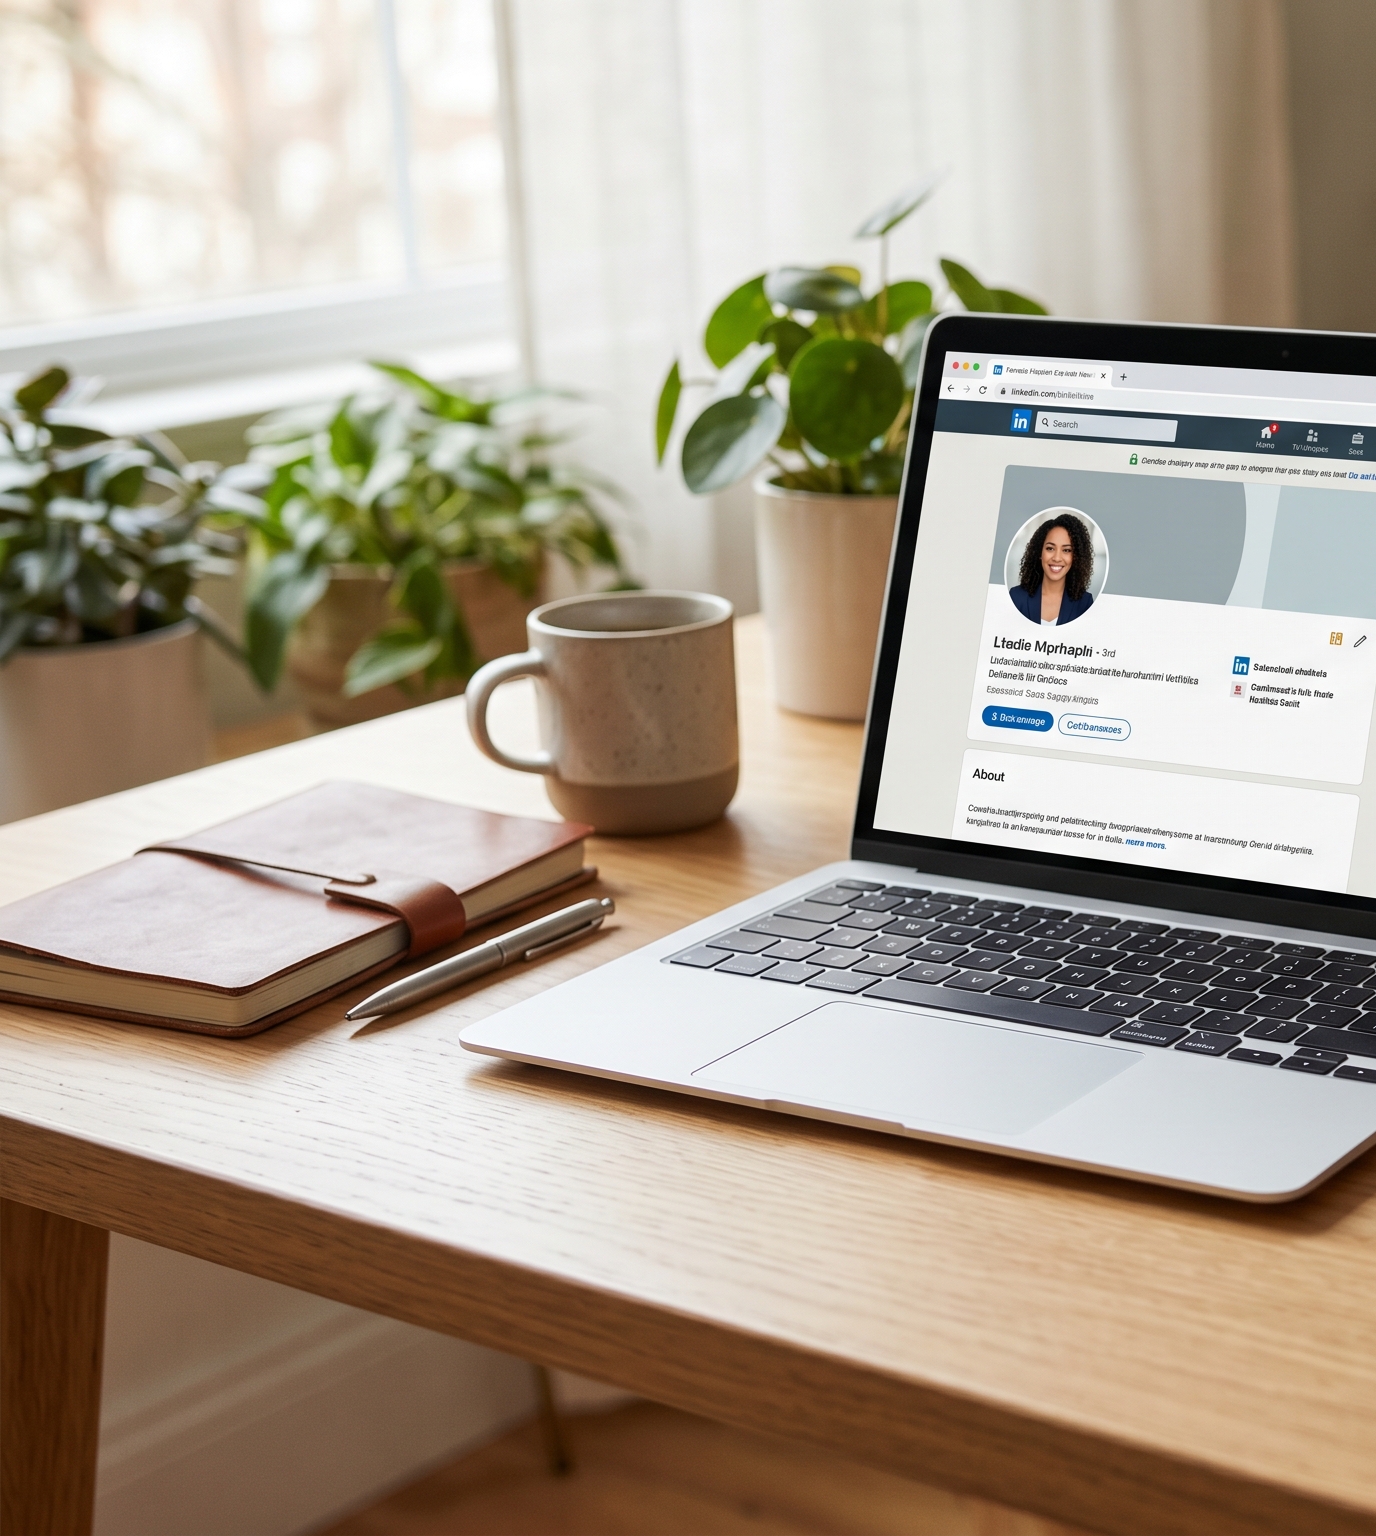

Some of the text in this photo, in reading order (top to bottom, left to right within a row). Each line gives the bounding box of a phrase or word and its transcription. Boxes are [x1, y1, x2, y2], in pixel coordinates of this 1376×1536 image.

[1013, 413, 1028, 429] in
[1052, 419, 1079, 429] Search
[1101, 648, 1117, 658] 3rd
[1235, 659, 1248, 674] in
[972, 768, 1006, 782] About
[1045, 813, 1059, 823] and
[1085, 832, 1096, 841] for
[1097, 833, 1104, 842] in
